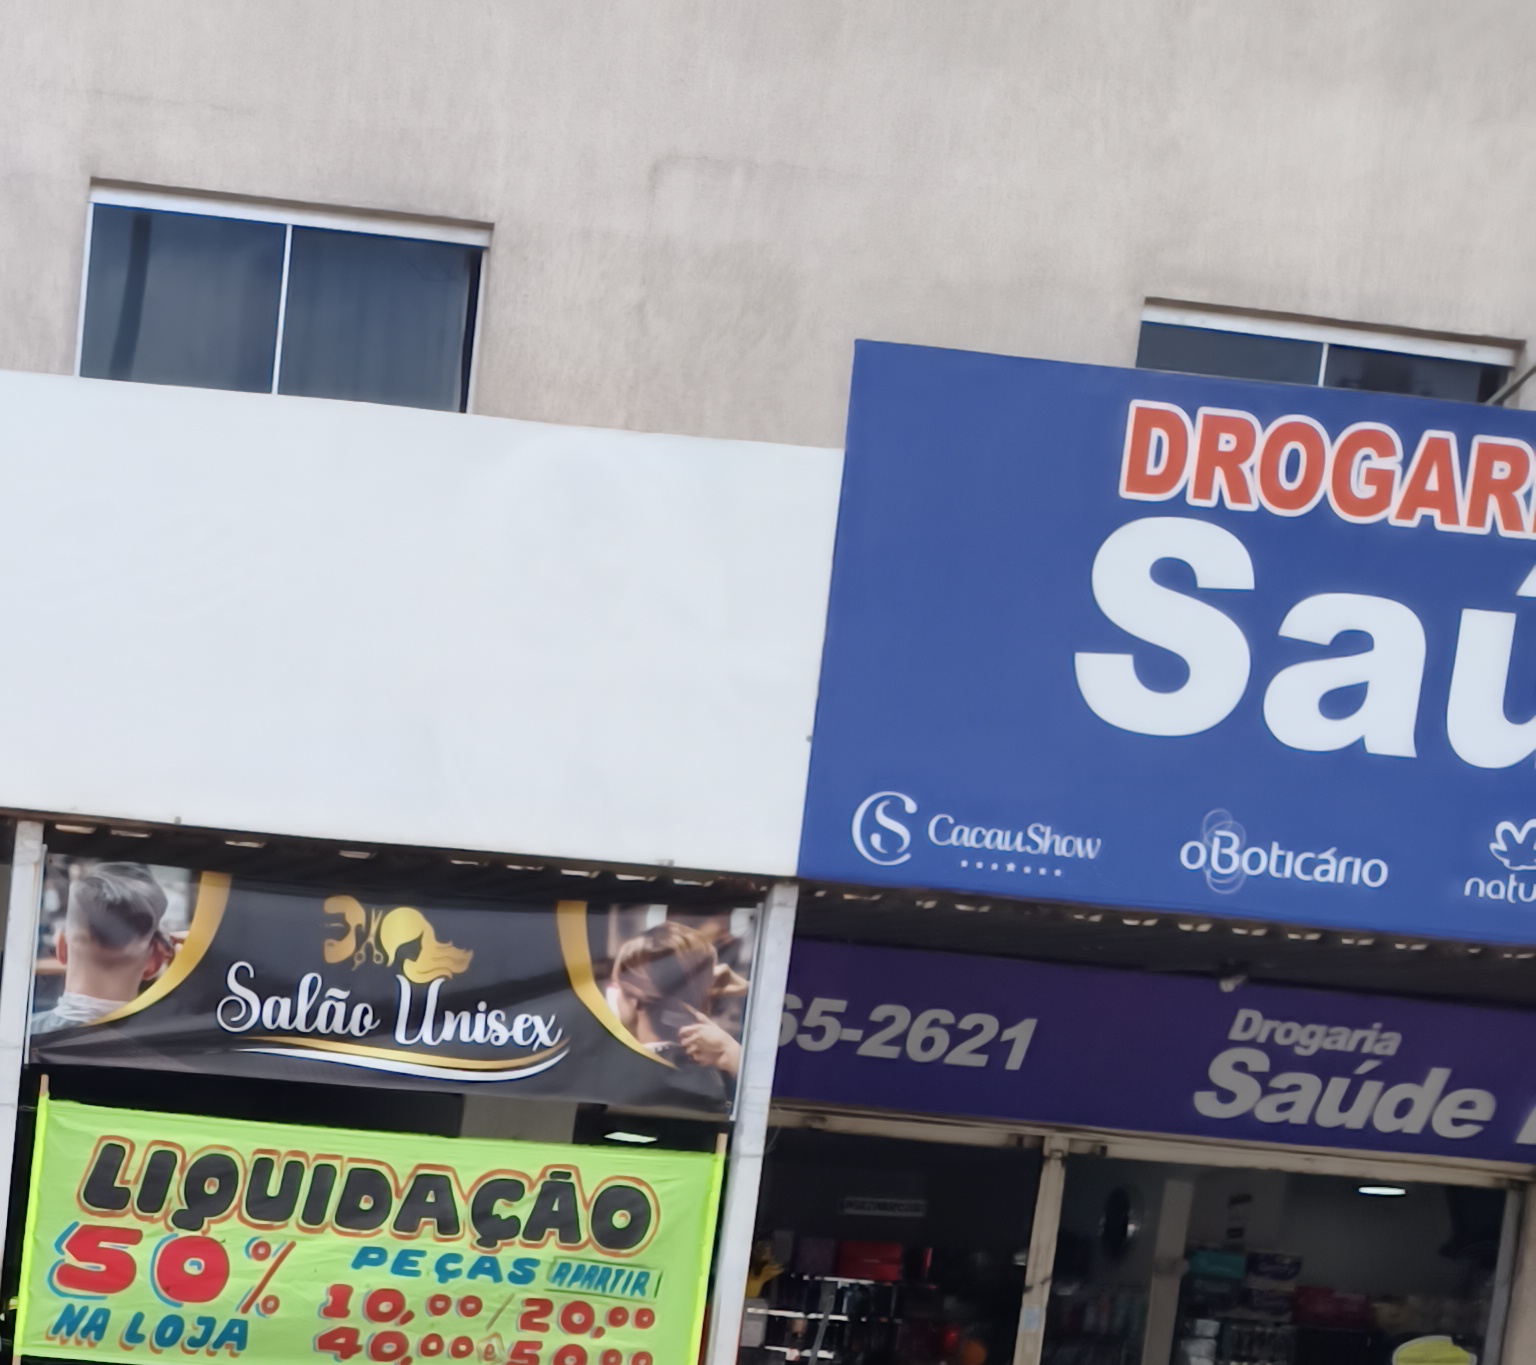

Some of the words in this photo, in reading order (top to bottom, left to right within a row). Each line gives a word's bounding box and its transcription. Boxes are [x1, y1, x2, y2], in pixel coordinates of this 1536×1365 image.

[1119, 399, 1536, 540] DROGAR
[216, 961, 381, 1037] Salão
[395, 974, 562, 1051] Unisex
[1228, 1008, 1402, 1056] Drogaria
[1193, 1046, 1497, 1139] Saúde
[77, 1135, 659, 1258] LIQUIDAÇÃO
[351, 1246, 541, 1285] PEÇAS
[43, 1303, 111, 1348] NA
[119, 1311, 249, 1358] LOJA
